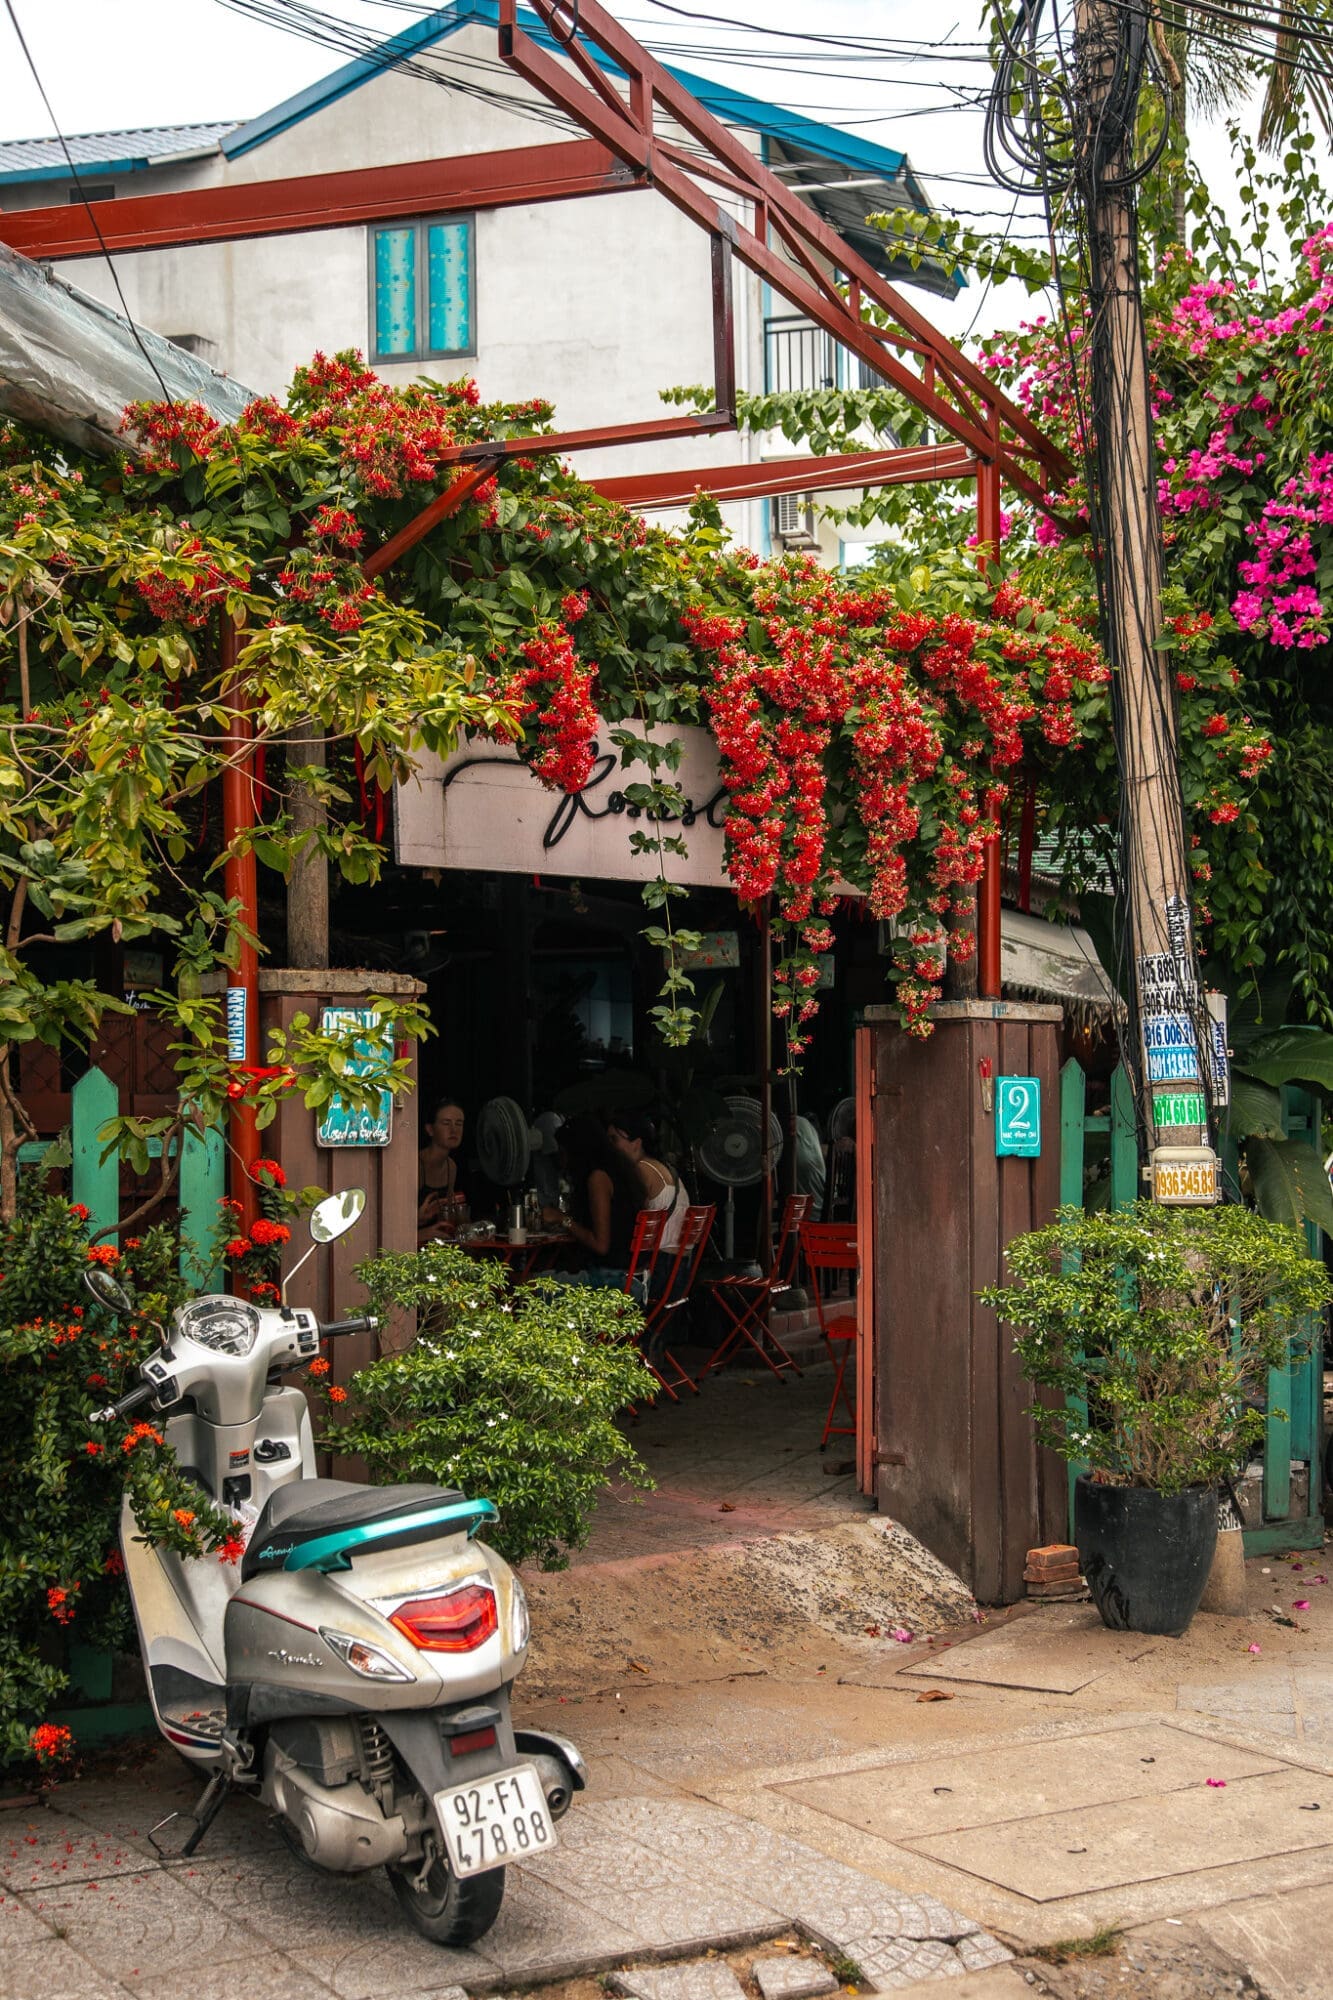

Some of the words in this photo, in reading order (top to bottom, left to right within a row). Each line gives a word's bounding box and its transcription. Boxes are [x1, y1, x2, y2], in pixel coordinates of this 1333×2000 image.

[319, 1117, 350, 1141] Closed
[1008, 1086, 1031, 1129] 2
[1156, 1170, 1214, 1197] 0936.545.83
[453, 1777, 525, 1827] 92-F1
[456, 1811, 547, 1868] 478.88
